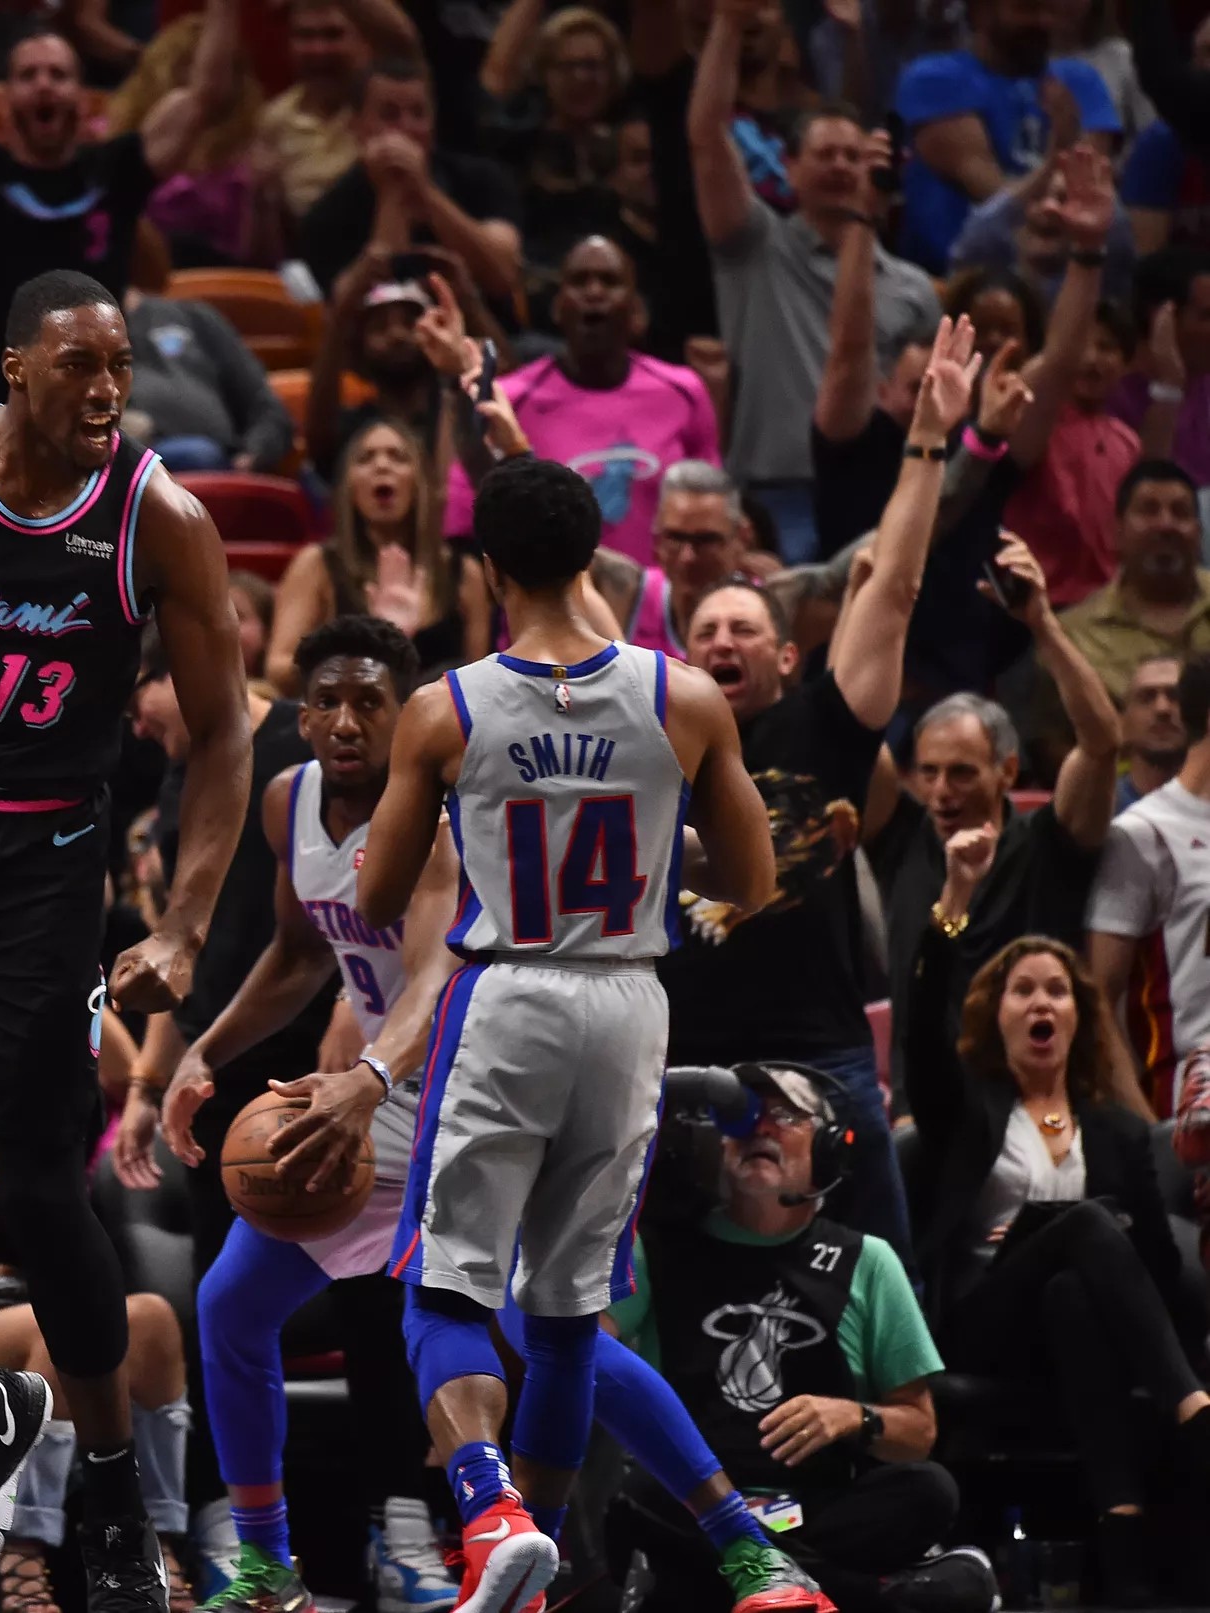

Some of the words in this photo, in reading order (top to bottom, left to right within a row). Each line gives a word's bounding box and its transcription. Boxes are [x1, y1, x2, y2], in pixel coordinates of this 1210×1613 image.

[65, 532, 115, 553] Ultimate
[65, 545, 111, 560] SOFTWARE
[508, 732, 616, 783] SMITH
[505, 794, 648, 945] 14
[344, 953, 387, 1017] 9
[809, 1242, 843, 1273] 27
